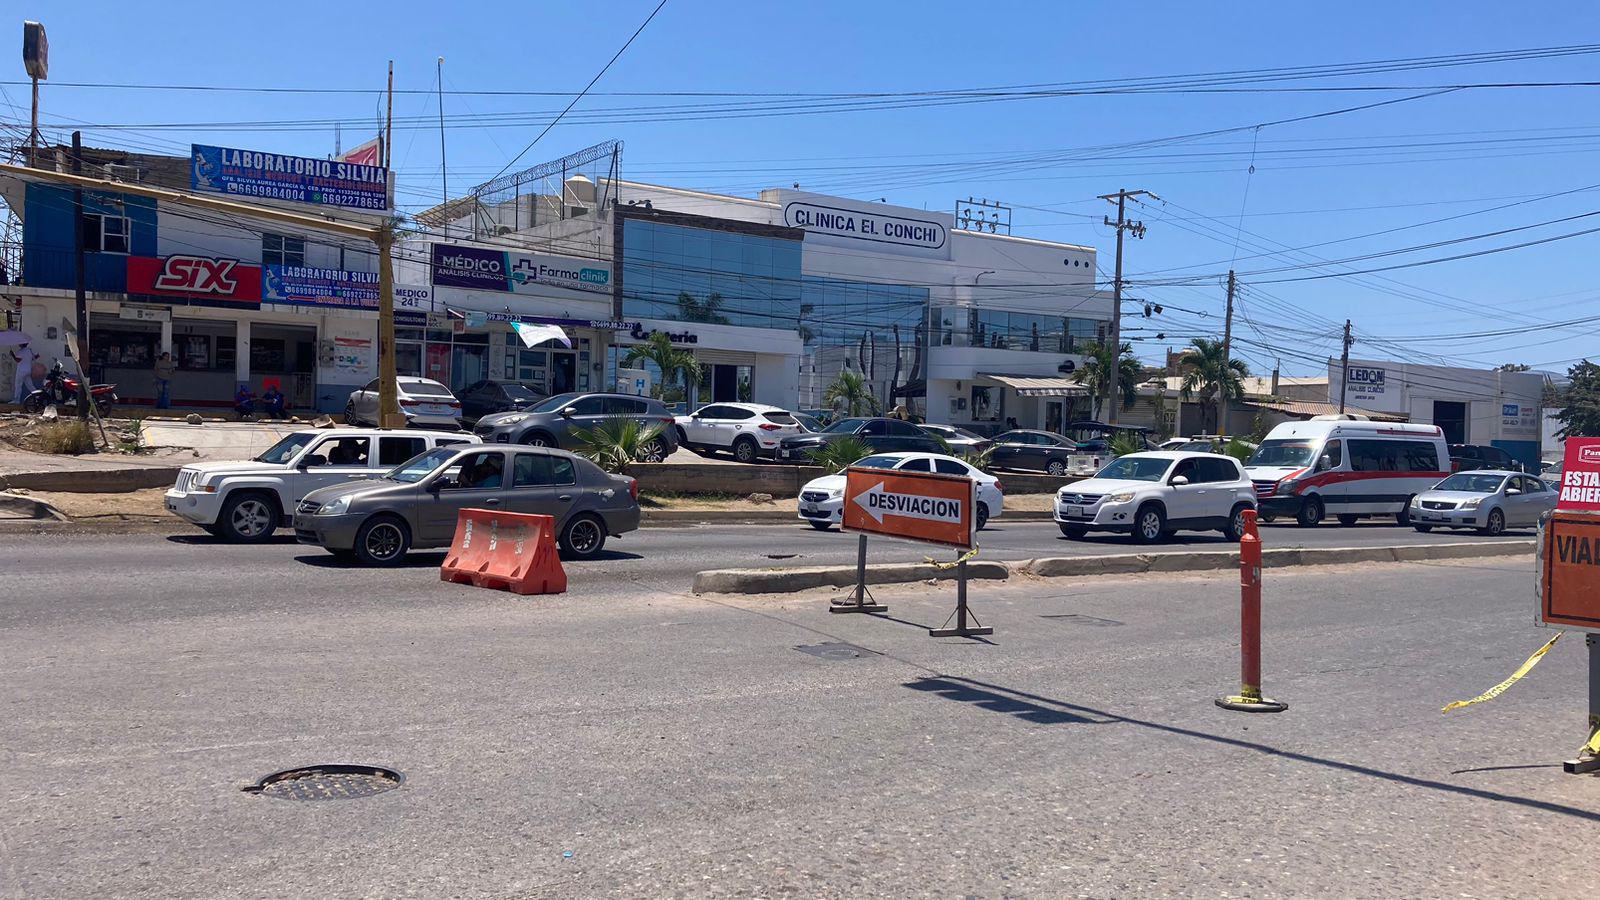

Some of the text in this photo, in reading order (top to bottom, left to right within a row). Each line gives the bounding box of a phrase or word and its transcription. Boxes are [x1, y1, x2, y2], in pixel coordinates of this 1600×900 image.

[222, 149, 385, 184] LABORATORIO SILVIA
[238, 183, 385, 209] 6699884004 6692278654
[795, 209, 936, 243] CLINICA EL CONCHI
[281, 265, 348, 281] LABORATORIO
[442, 253, 500, 274] MÉDICO
[342, 290, 380, 300] 669227865
[395, 288, 428, 298] MEDICO
[401, 297, 413, 307] 24
[869, 492, 959, 518] DESVIACION
